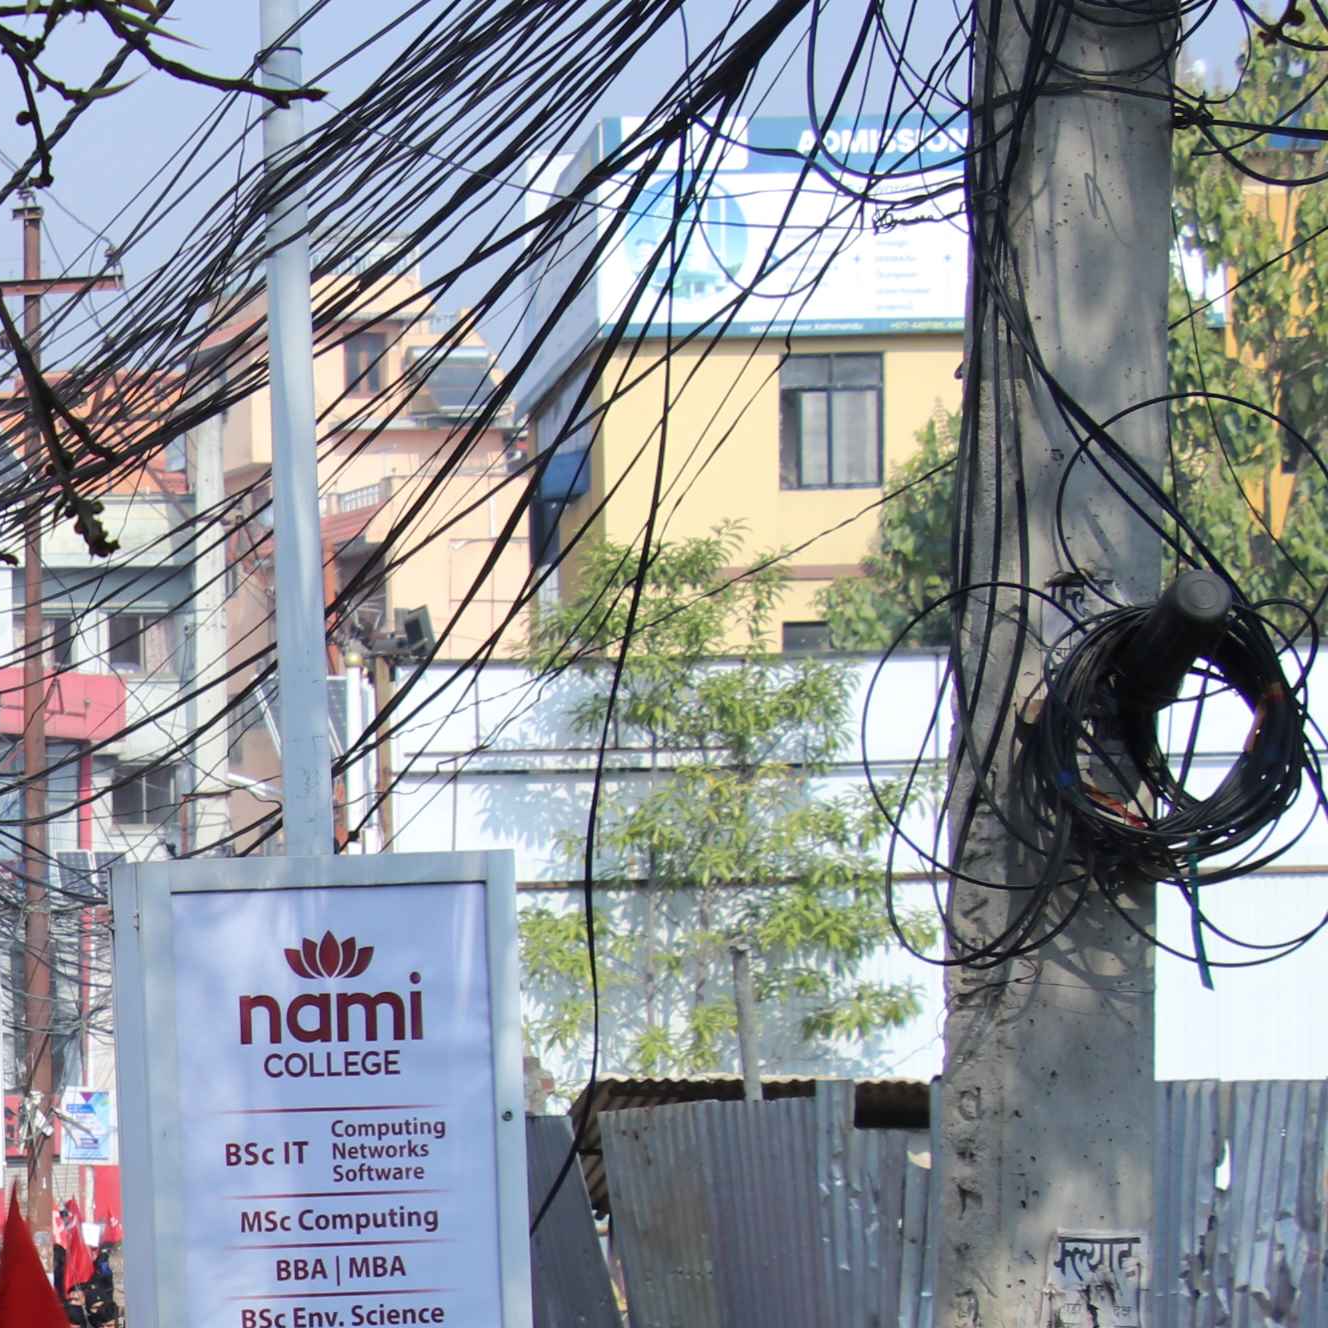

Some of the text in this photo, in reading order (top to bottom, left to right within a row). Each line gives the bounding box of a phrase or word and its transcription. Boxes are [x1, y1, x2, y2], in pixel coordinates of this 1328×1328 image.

[239, 971, 424, 1044] nami
[264, 1050, 401, 1078] COLLEGE
[331, 1117, 446, 1142] Computing
[225, 1141, 309, 1166] BSc IT
[332, 1140, 430, 1161] Networks
[333, 1163, 425, 1182] Software
[240, 1206, 440, 1235] MSc Computing
[276, 1258, 329, 1282] BBA
[348, 1255, 407, 1279] MBA
[293, 1307, 345, 1328] Env.
[351, 1304, 445, 1328] Science
